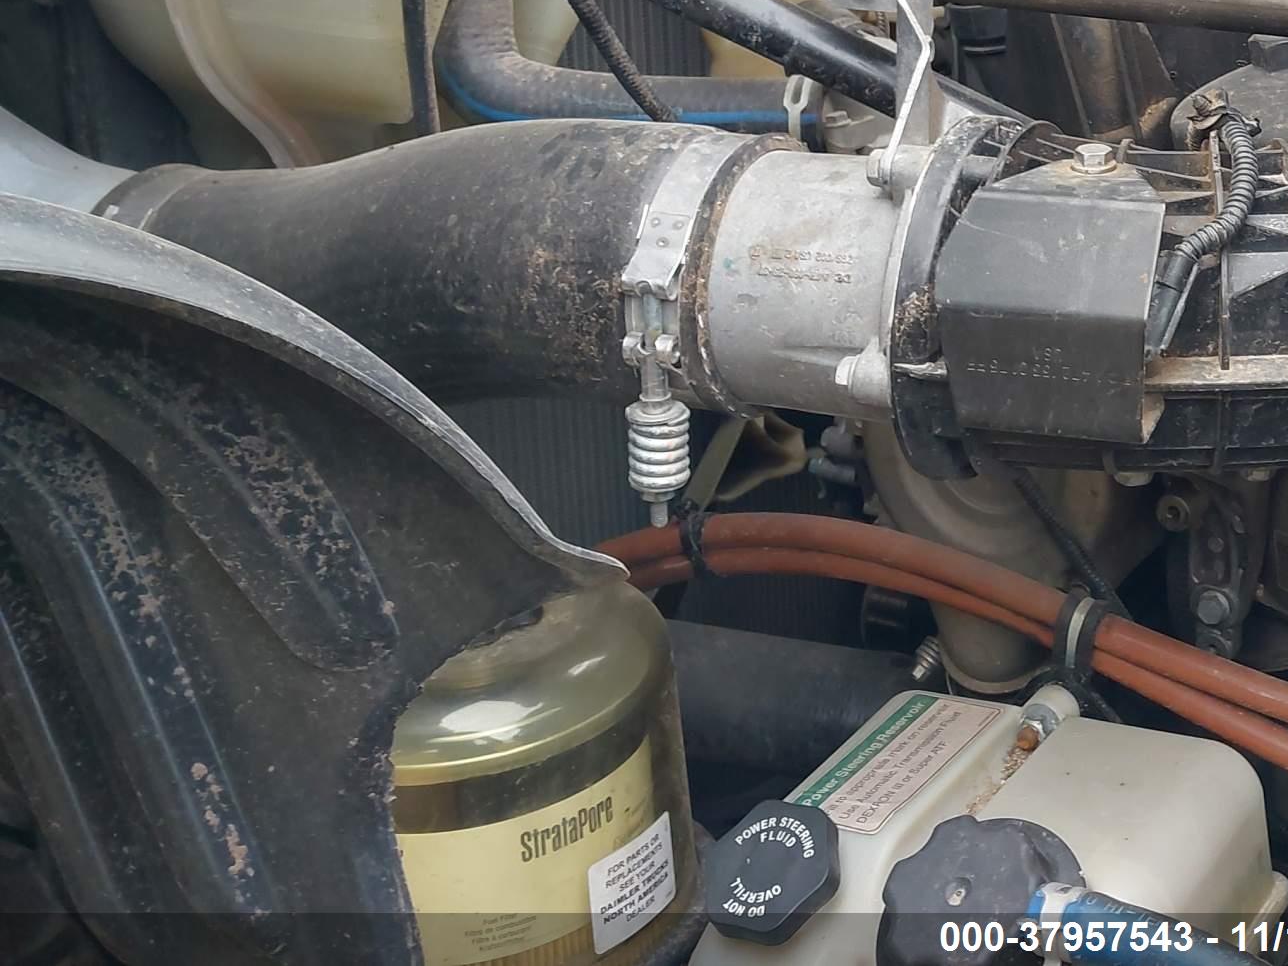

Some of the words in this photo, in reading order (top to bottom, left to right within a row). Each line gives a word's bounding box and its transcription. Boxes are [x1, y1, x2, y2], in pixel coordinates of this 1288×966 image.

[802, 777, 838, 806] Power
[835, 742, 880, 777] Steering
[876, 702, 924, 744] Reservoir
[837, 796, 848, 808] to
[907, 729, 921, 743] on
[839, 802, 860, 820] Use
[858, 770, 899, 804] Automatic
[856, 790, 896, 824] DEXRON
[902, 774, 914, 785] or
[911, 756, 933, 776] Super
[933, 740, 949, 756] ATF
[520, 795, 613, 863] StrataPore
[735, 817, 777, 845] POWER
[779, 817, 815, 858] STEERING
[760, 831, 797, 847] FLUID
[605, 841, 663, 889] REPLACEMENTS
[608, 860, 625, 876] FOR
[626, 842, 650, 864] PARTS
[650, 833, 660, 847] OR
[619, 876, 635, 892] SEE
[636, 860, 656, 880] YOUR
[600, 884, 640, 914] DAIMLER
[641, 858, 669, 887] TRUCKS
[603, 899, 636, 925] NORTH
[637, 871, 669, 903] AMERICA
[626, 895, 656, 922] DEALER
[722, 898, 746, 916] NOT
[730, 877, 781, 904] OVERFILL
[747, 905, 765, 917] DO
